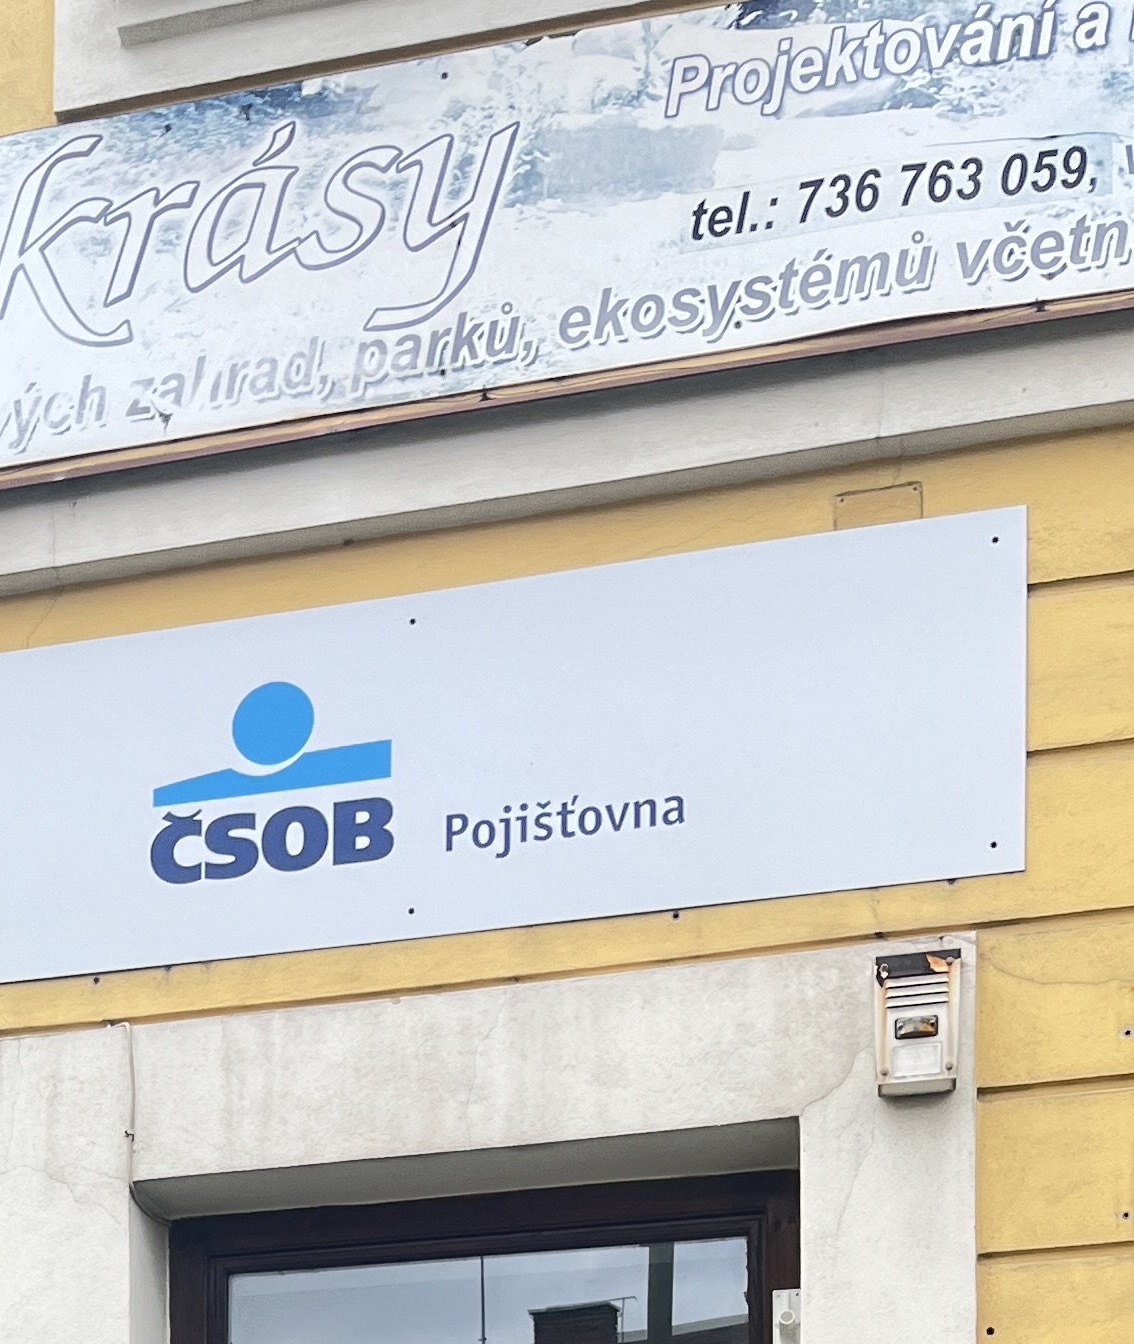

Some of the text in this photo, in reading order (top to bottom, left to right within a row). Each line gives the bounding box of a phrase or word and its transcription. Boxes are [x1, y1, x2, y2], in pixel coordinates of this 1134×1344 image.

[664, 0, 1059, 118] Projektování
[1072, 2, 1112, 51] a
[691, 191, 778, 240] tel.:
[798, 169, 881, 224] 736
[901, 156, 983, 207] 763
[999, 145, 1098, 195] 059,
[352, 302, 540, 396] parků,
[559, 230, 939, 348] ekosystémů
[150, 796, 395, 885] ČSOB
[445, 795, 686, 858] Pojišťovna
